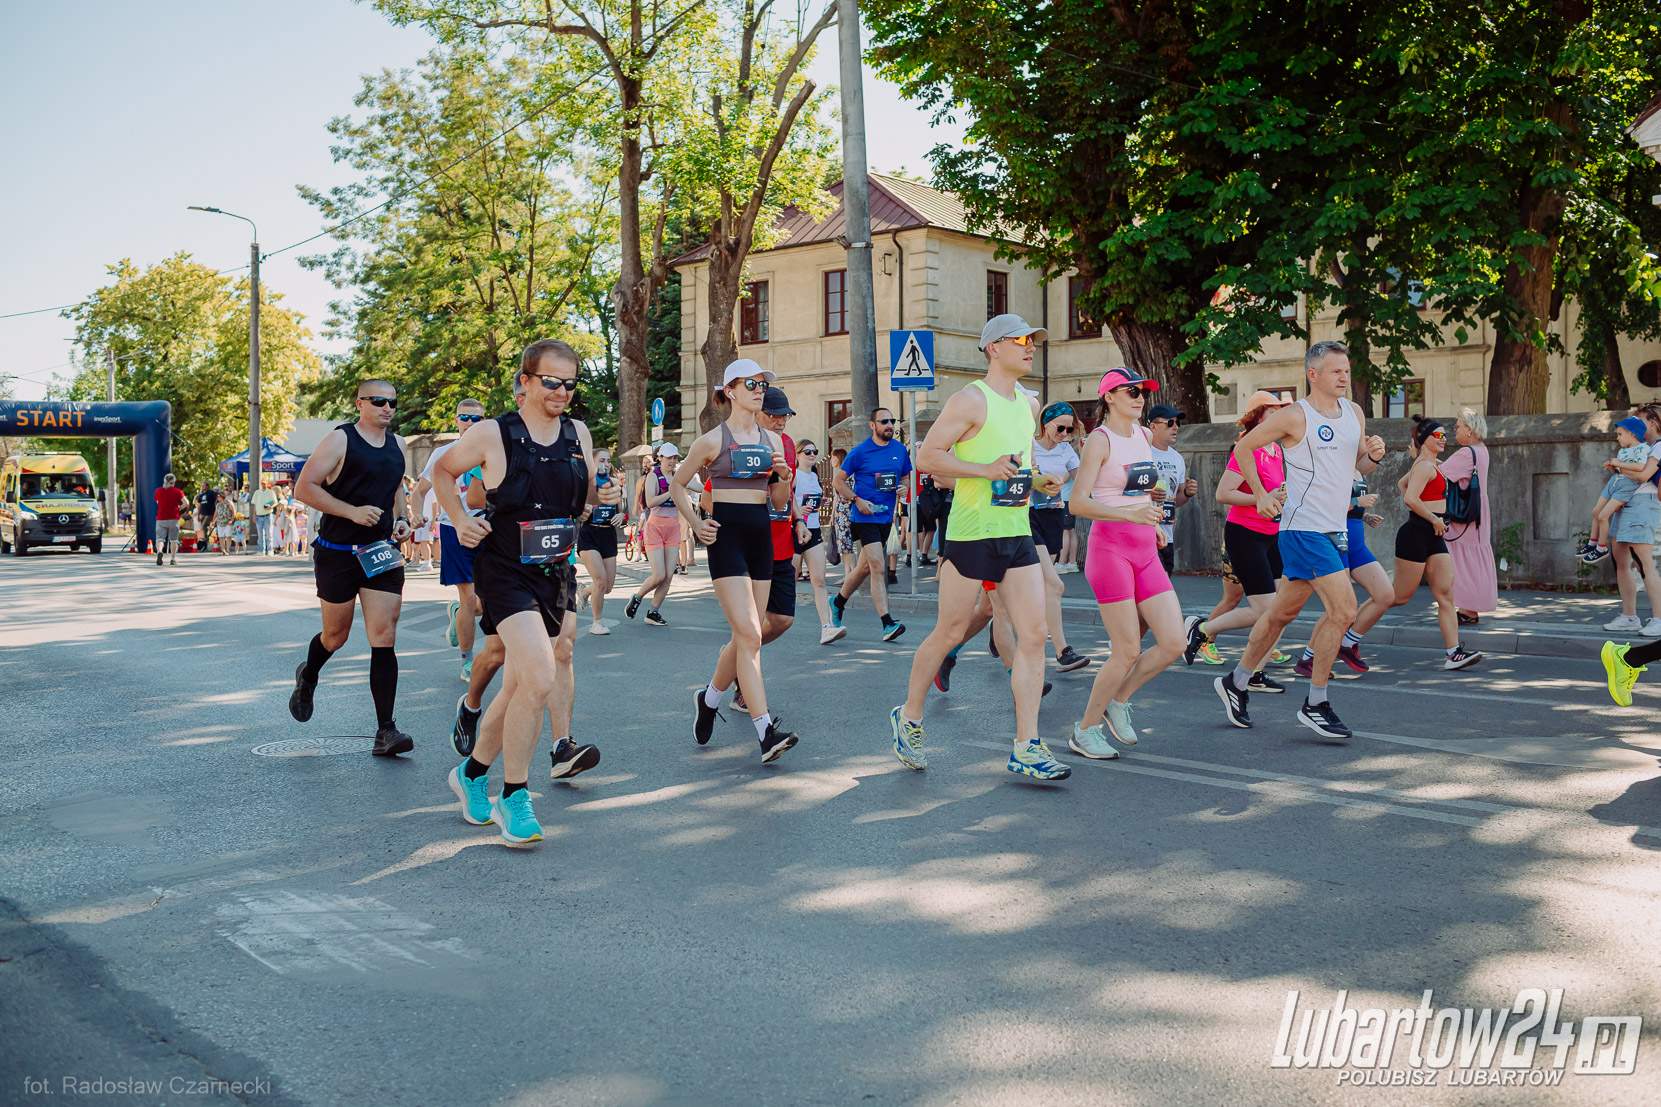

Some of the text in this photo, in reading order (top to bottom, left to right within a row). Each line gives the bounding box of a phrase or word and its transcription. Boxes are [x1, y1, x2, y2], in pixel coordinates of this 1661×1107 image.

[16, 410, 86, 428] START
[746, 456, 761, 467] 30
[884, 478, 893, 486] 38
[1137, 474, 1150, 486] 48
[1009, 483, 1024, 495] 45
[601, 510, 610, 518] 25
[541, 535, 560, 549] 65
[370, 550, 393, 565] 108
